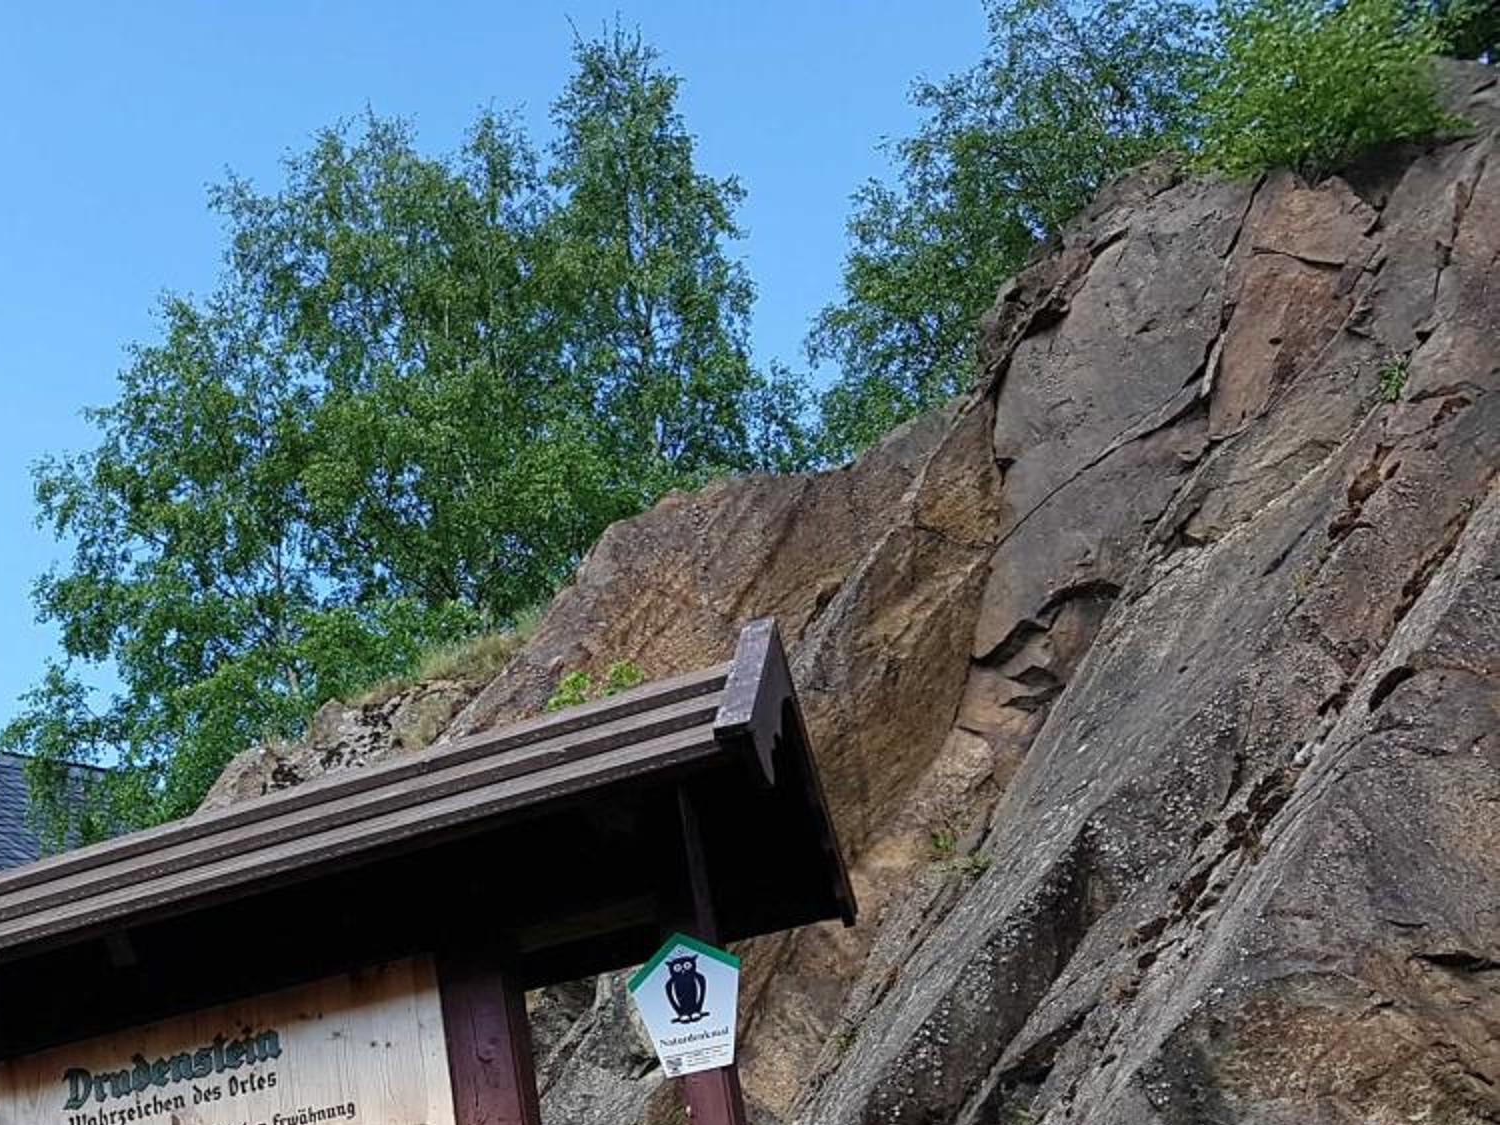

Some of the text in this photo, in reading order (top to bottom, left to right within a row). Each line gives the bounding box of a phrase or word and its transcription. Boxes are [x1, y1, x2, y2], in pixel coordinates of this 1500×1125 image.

[62, 1026, 283, 1111] Drudenstein
[192, 1085, 223, 1105] des
[228, 1071, 277, 1097] Ortes
